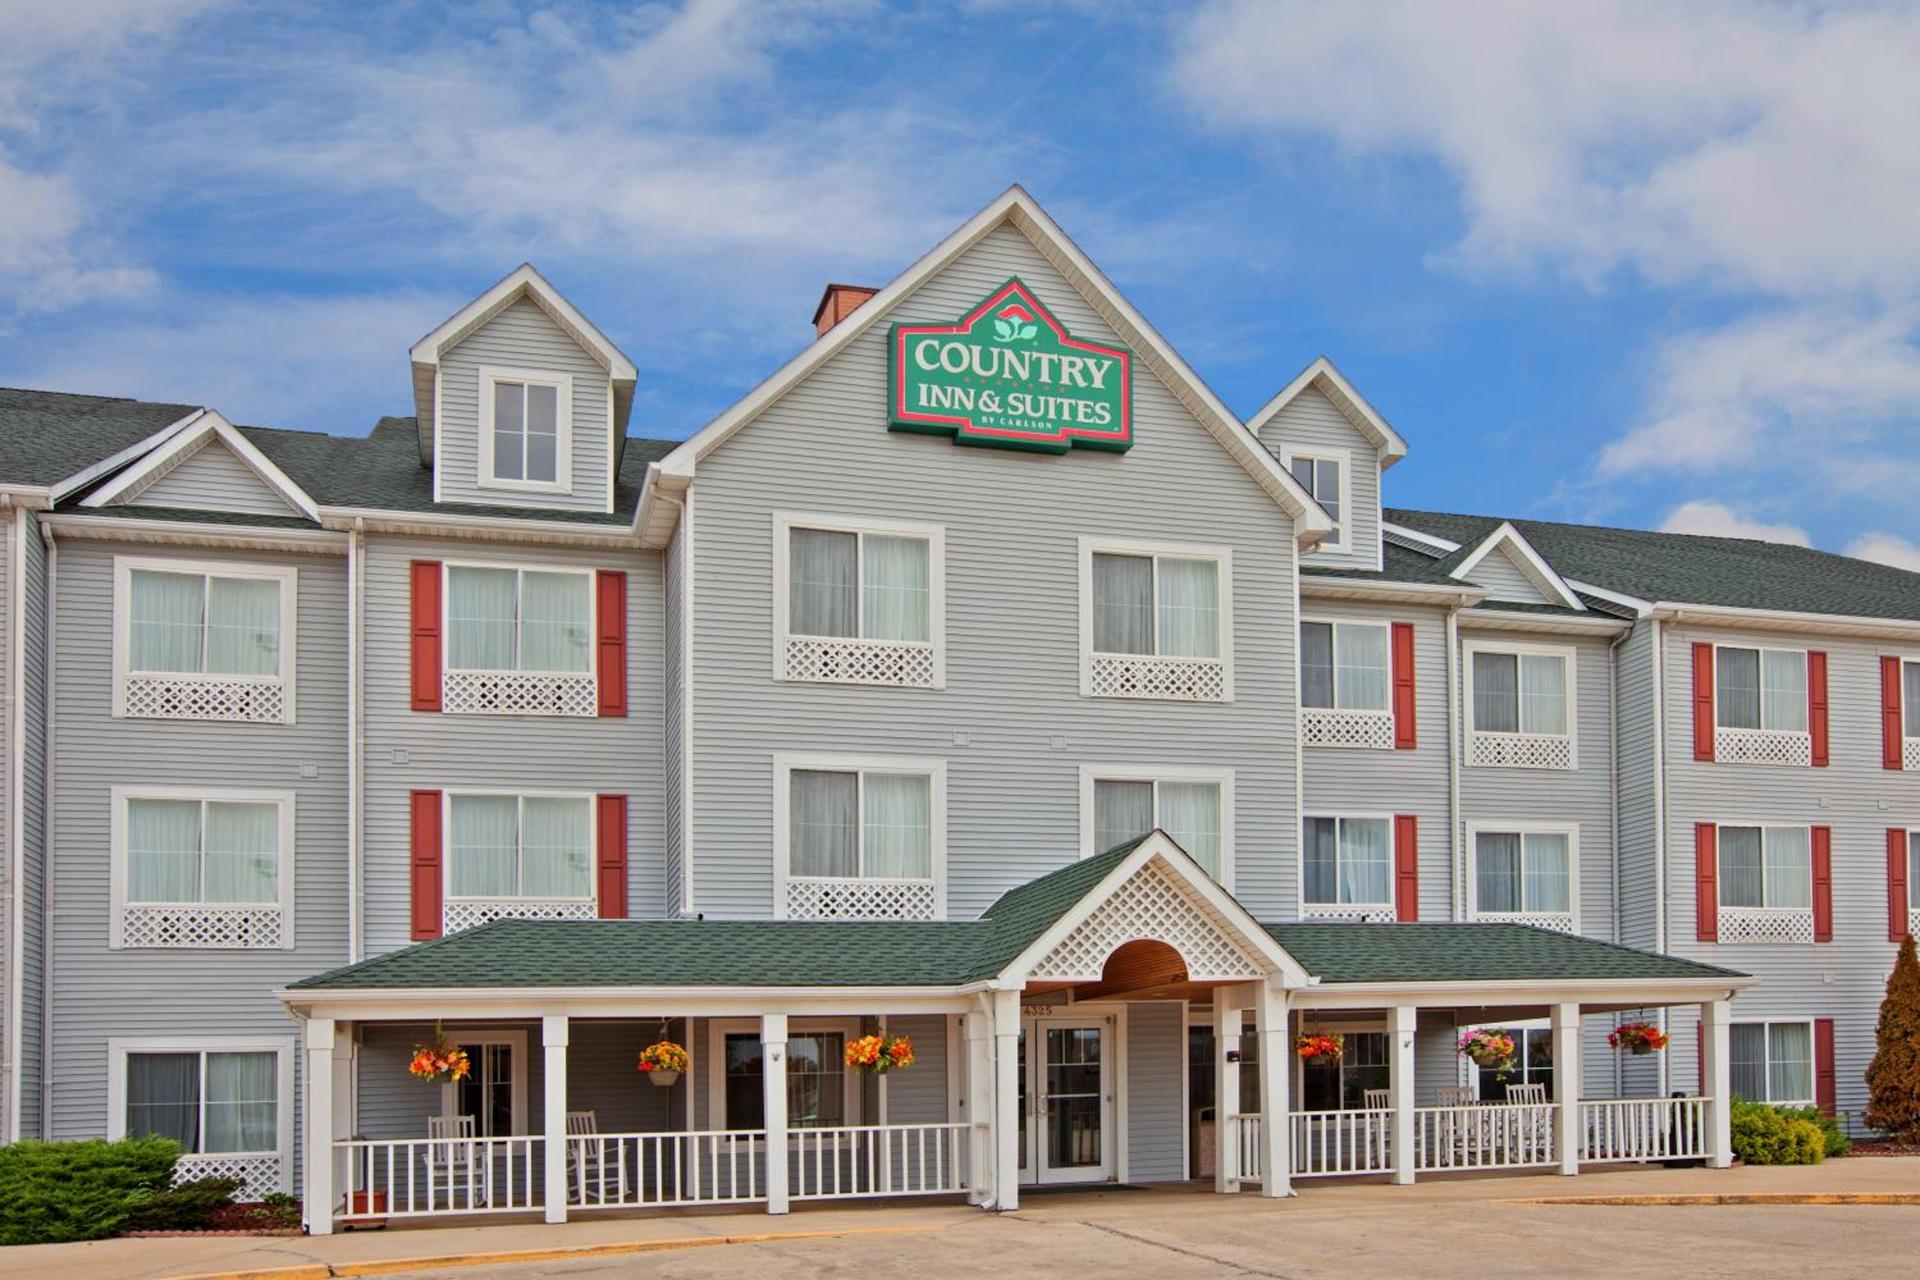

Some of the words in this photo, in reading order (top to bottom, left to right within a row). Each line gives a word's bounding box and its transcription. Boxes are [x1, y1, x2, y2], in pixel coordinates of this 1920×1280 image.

[914, 339, 1114, 389] COUNTRY
[1007, 392, 1112, 424] SUITES
[981, 416, 995, 424] BY
[999, 418, 1053, 430] CARLSON
[1023, 1005, 1052, 1016] 4325
